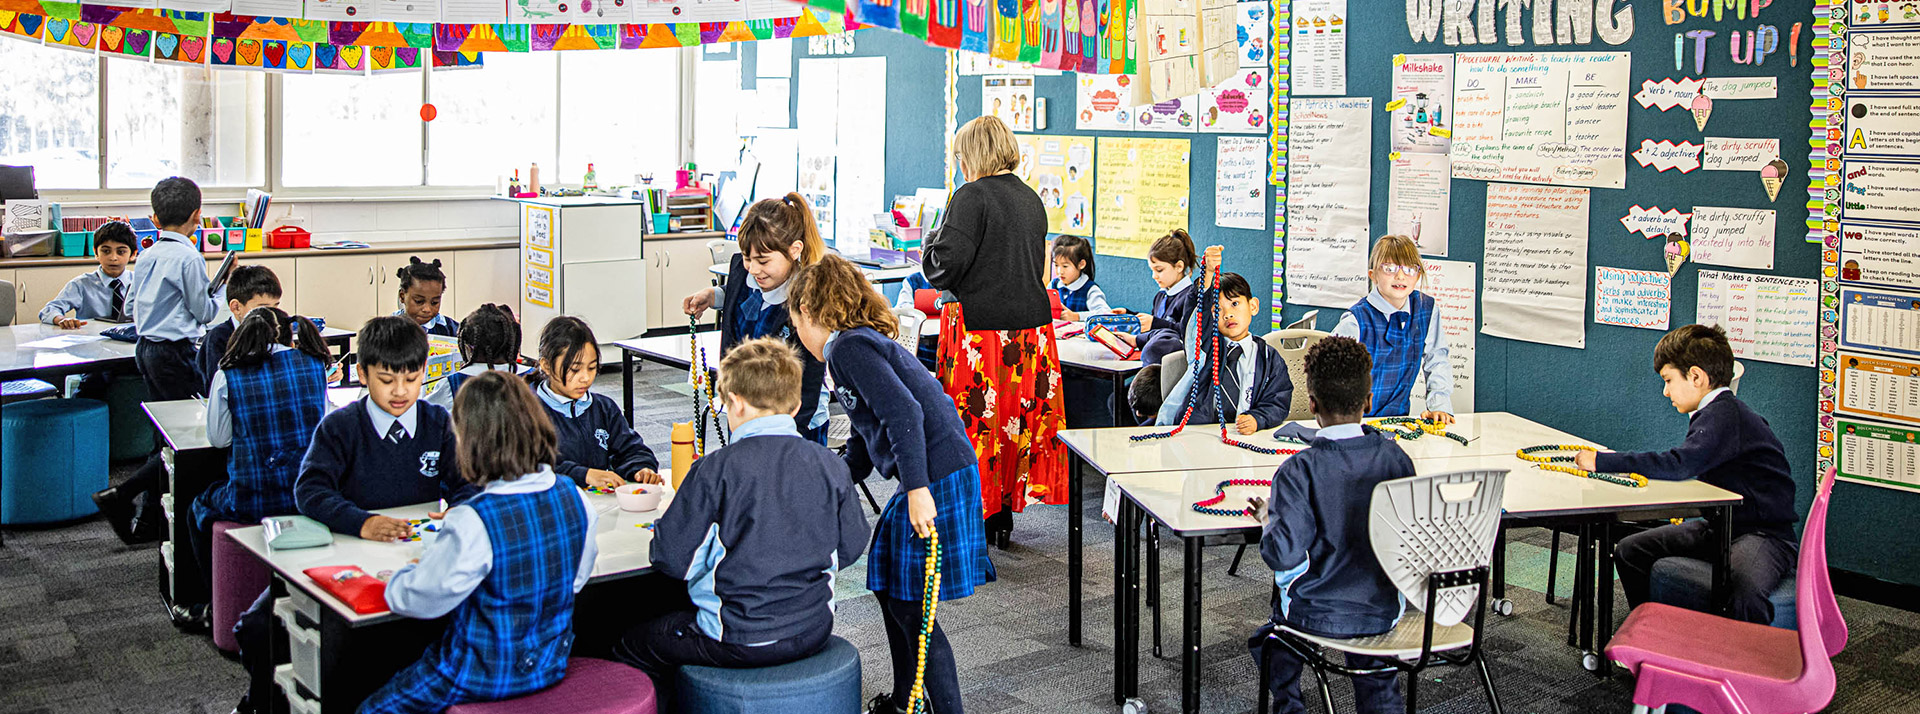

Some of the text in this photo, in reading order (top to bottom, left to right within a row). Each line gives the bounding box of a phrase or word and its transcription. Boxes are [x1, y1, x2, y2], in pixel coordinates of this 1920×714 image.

[1663, 0, 1773, 25] BUMP
[1405, 0, 1634, 46] WRITING
[1675, 29, 1716, 75] IT
[1550, 54, 1571, 63] teach
[1573, 54, 1586, 63] the
[1590, 54, 1616, 62] reader
[1402, 63, 1443, 72] Milkshake
[1487, 64, 1494, 72] to
[1510, 64, 1549, 75] something
[1467, 79, 1479, 87] DO
[1706, 80, 1773, 93] The dog jumped
[1577, 90, 1621, 100] good friend
[1336, 100, 1369, 109] Newsletter
[1849, 128, 1867, 149] A
[1706, 141, 1718, 150] The
[1744, 138, 1777, 153] scruffy
[1651, 148, 1696, 160] 2 adjectives
[1706, 153, 1722, 167] dog
[1847, 166, 1867, 180] and
[1846, 182, 1866, 196] first
[1638, 215, 1661, 224] adverb
[1694, 210, 1706, 221] The
[1732, 210, 1766, 225] scruffy
[1645, 224, 1670, 233] details
[1692, 223, 1746, 239] dog jumped
[1844, 231, 1863, 240] we
[1692, 236, 1771, 252] excitedly into the
[1694, 250, 1712, 260] lake
[1602, 270, 1669, 286] Using adjectives
[1637, 289, 1666, 298] adverbs
[1637, 299, 1668, 312] interesting
[1730, 326, 1743, 335] sing
[1791, 352, 1812, 360] Sunday
